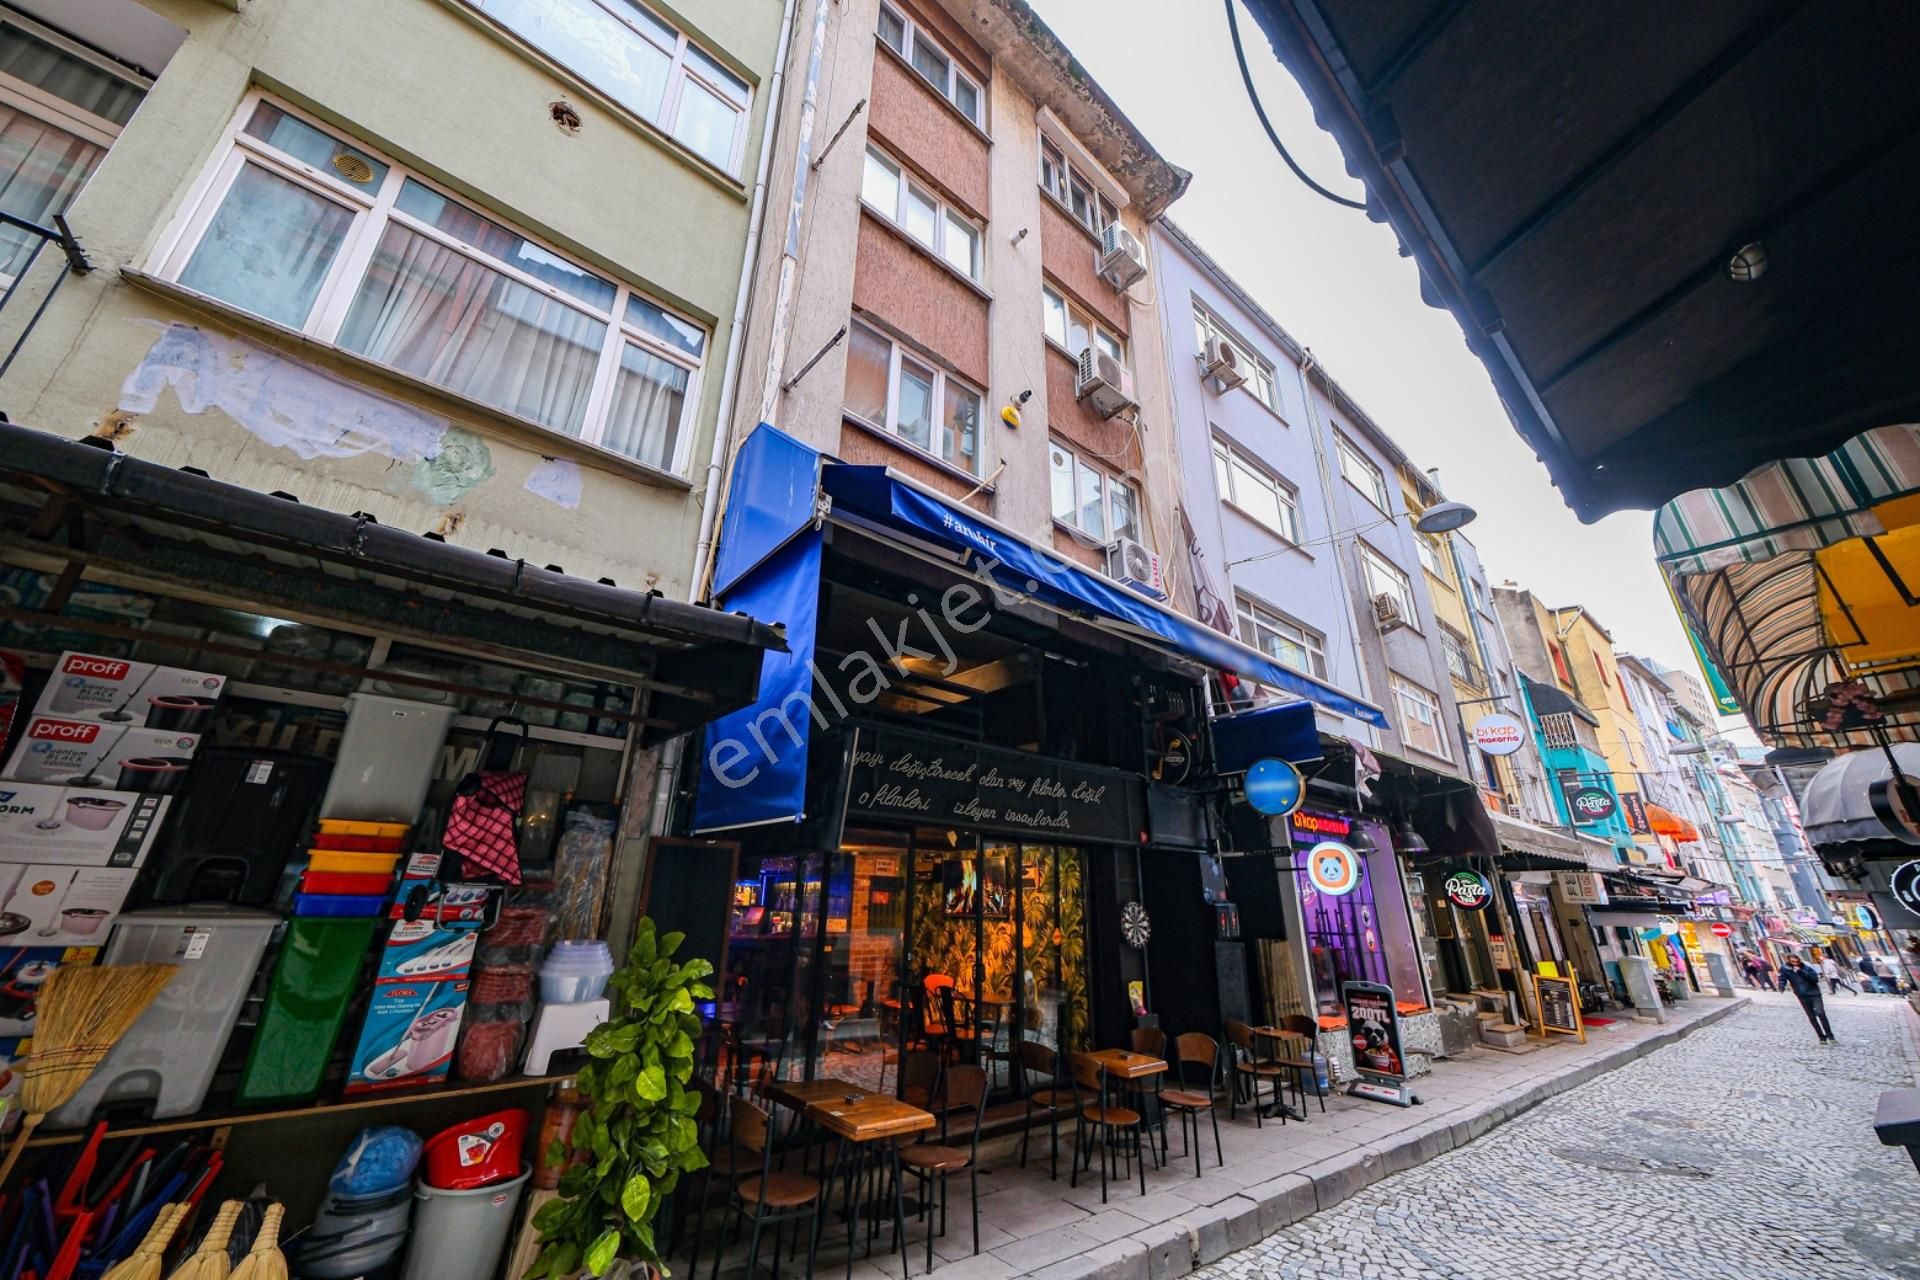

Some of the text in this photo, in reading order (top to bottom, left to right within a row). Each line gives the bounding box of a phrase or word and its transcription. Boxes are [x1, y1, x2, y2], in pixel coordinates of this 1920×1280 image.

[67, 658, 125, 676] proff
[33, 722, 95, 738] proff
[979, 767, 1004, 788] olan
[858, 791, 869, 805] o
[867, 783, 932, 810] filmleri
[953, 798, 997, 822] izleyen
[1576, 796, 1611, 811] Pasta
[1445, 878, 1487, 897] Pasta
[1350, 1006, 1391, 1024] 200TL
